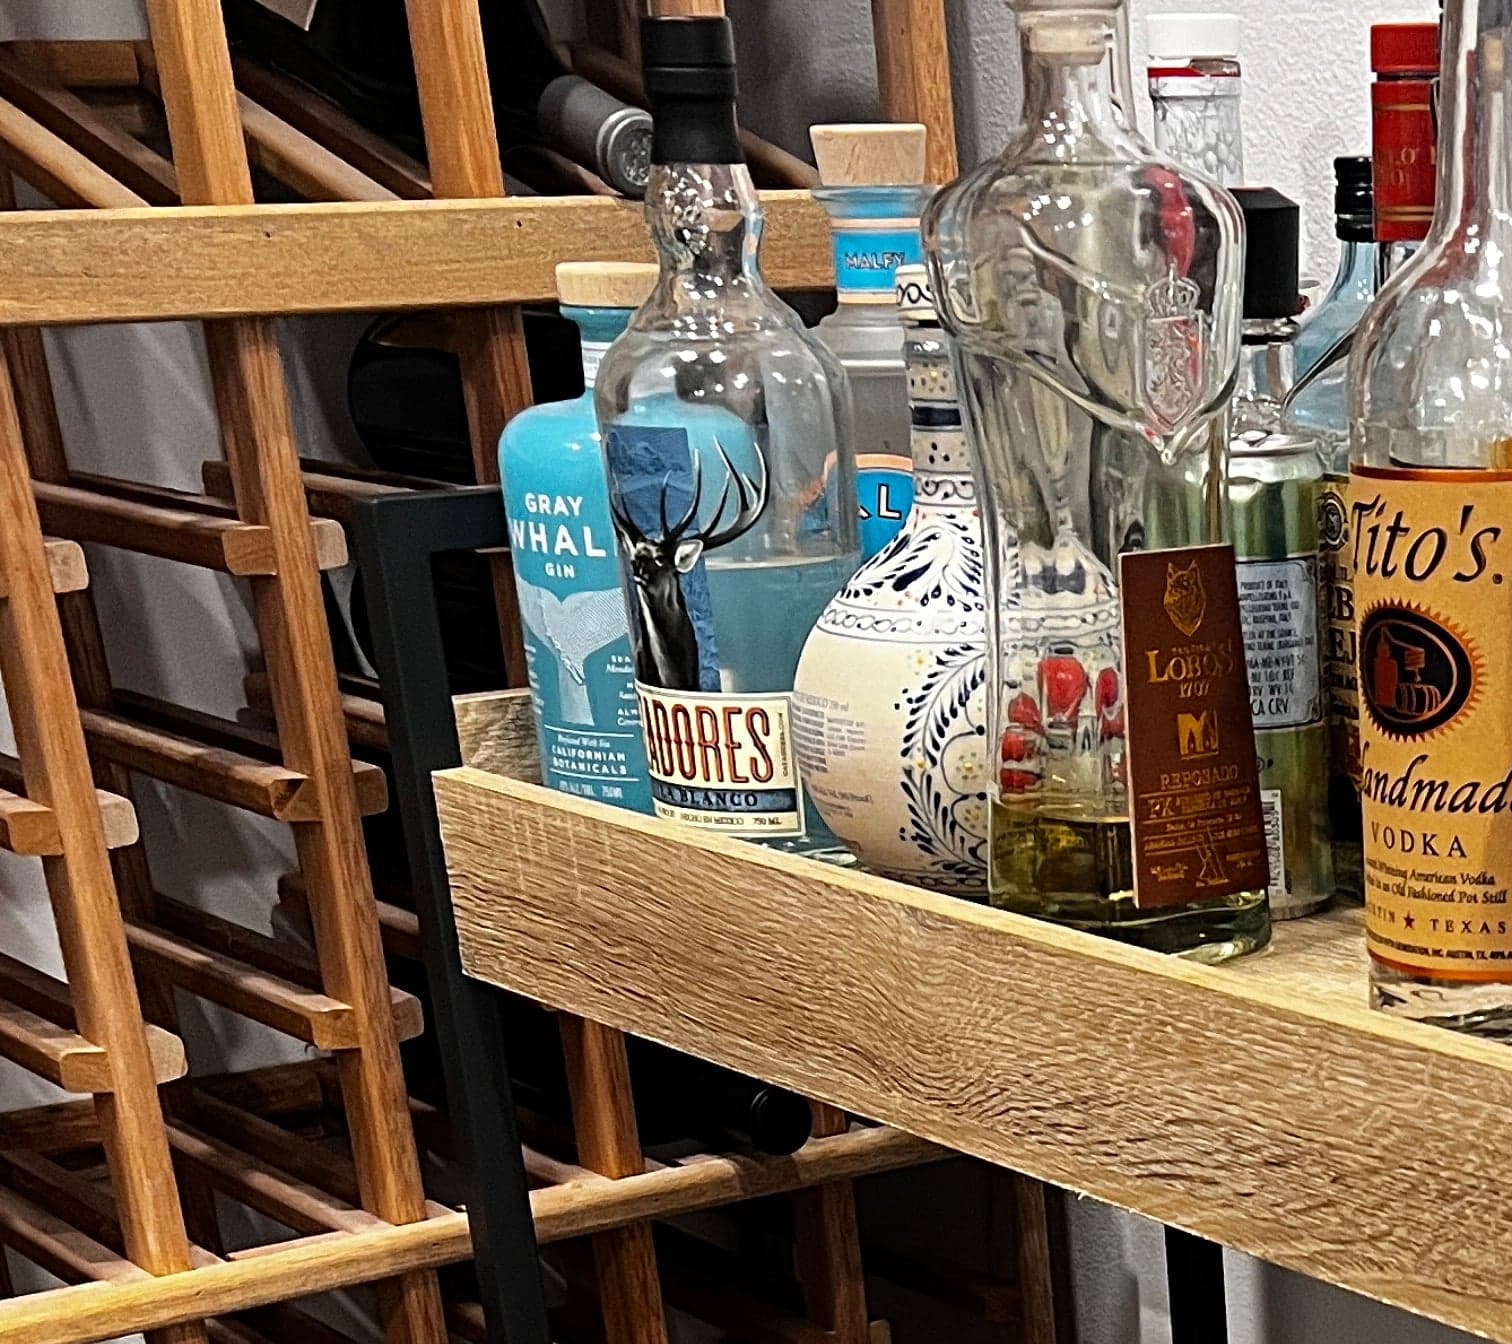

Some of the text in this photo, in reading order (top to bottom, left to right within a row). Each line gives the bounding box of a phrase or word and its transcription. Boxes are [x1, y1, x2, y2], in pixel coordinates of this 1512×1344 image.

[845, 251, 905, 270] MALFY
[525, 492, 583, 517] GRAY
[511, 519, 610, 558] WHAL
[545, 563, 575, 578] GIN
[552, 744, 626, 761] CALIFORNIAN
[553, 756, 627, 775] BOTANICALS
[680, 787, 758, 807] BLANCO
[1371, 821, 1467, 858] VODKA
[1410, 869, 1457, 884] American
[1460, 871, 1496, 885] Vodka
[1458, 891, 1478, 904] Pot
[1481, 889, 1508, 904] Still
[1430, 918, 1507, 934] TEXAS
